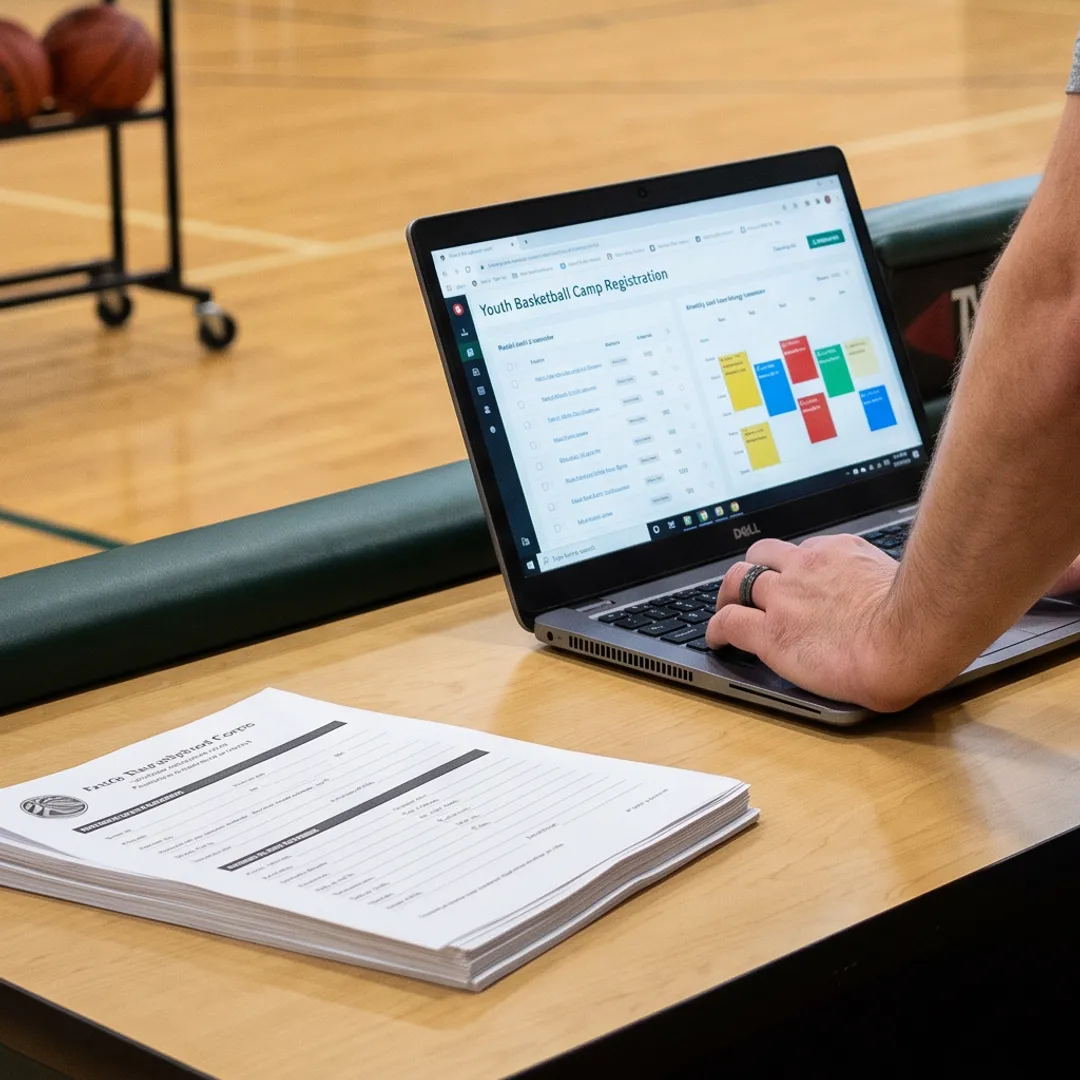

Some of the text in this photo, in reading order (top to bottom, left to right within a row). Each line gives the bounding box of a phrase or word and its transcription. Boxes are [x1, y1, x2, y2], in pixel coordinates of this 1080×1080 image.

[479, 269, 668, 317] Youth Basketball Camp Registration
[733, 523, 761, 540] DELL
